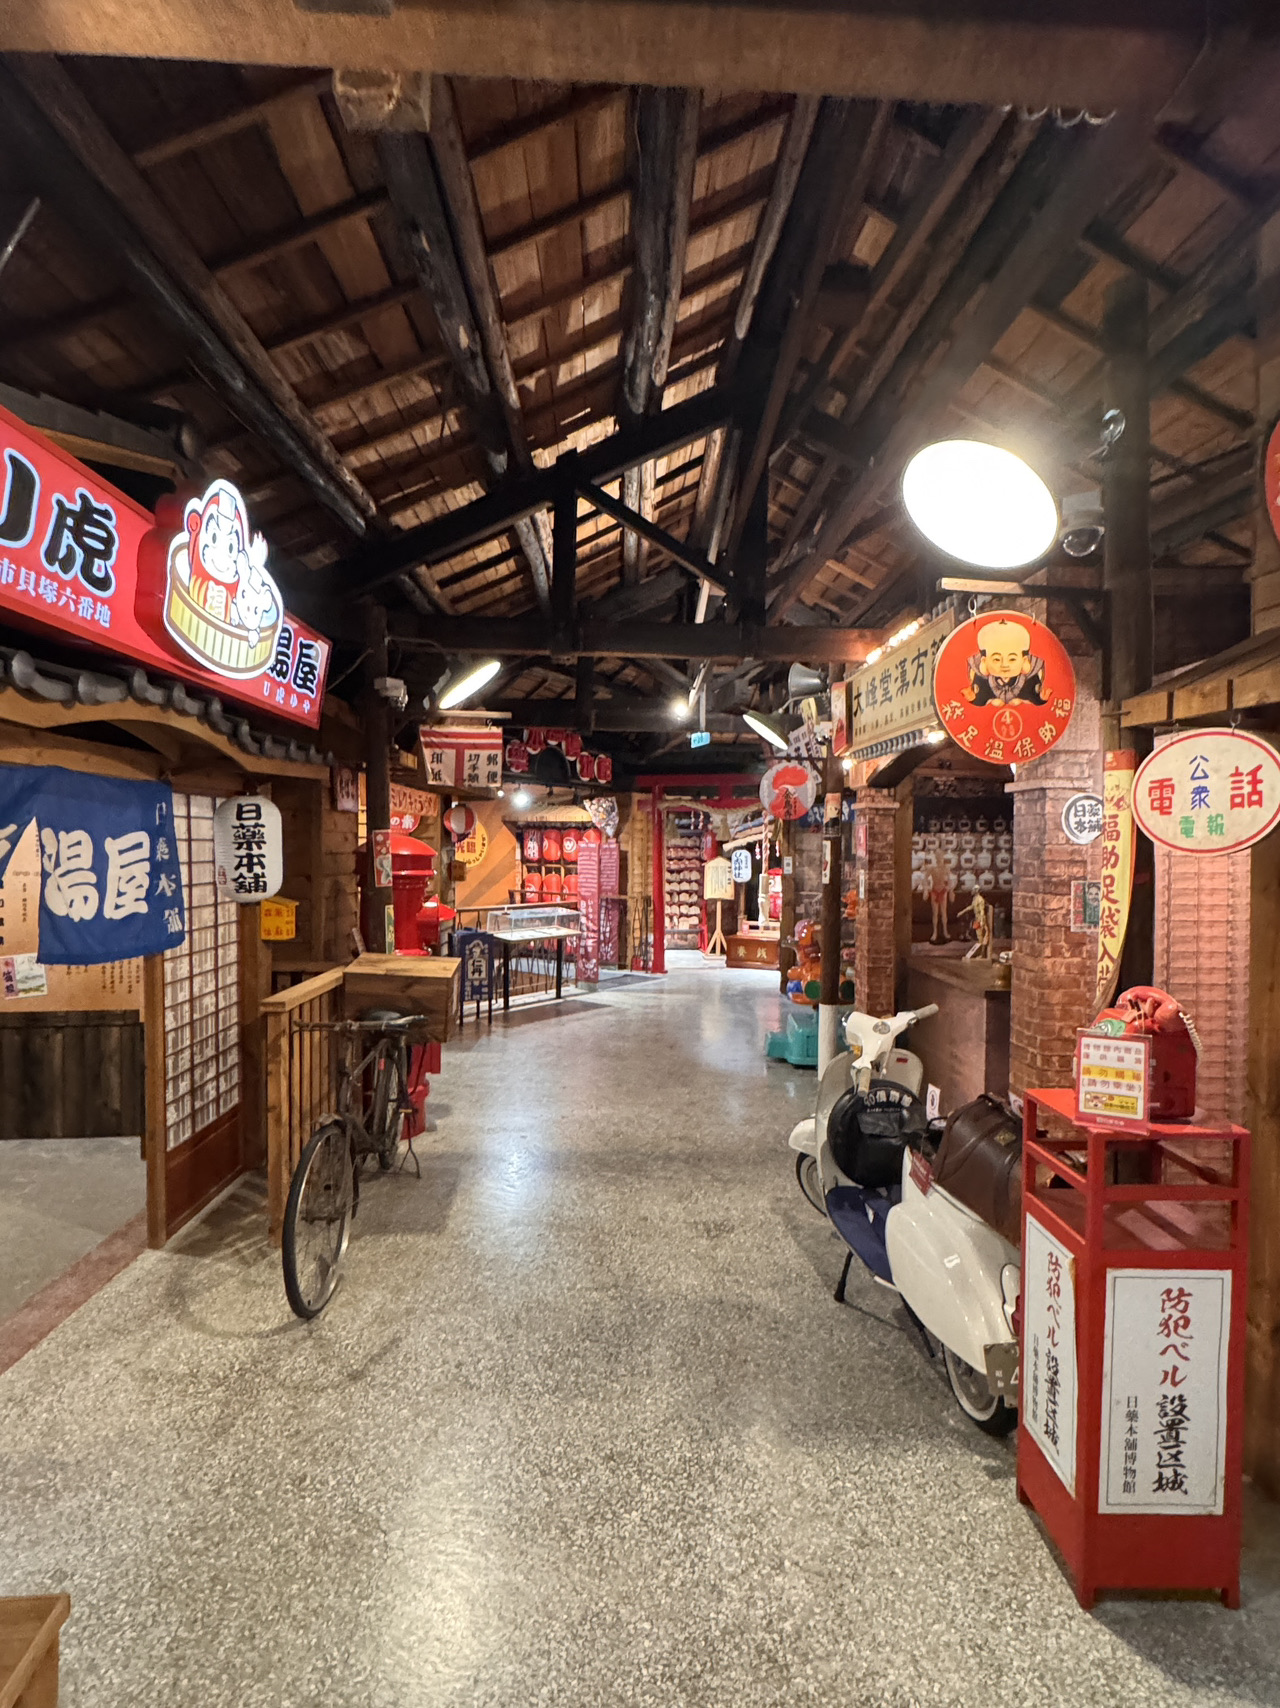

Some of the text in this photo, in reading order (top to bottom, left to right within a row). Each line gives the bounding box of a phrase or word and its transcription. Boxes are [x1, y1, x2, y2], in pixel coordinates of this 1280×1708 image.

[854, 634, 947, 718] 大峰堂漢方
[486, 753, 499, 784] 郵便
[1179, 813, 1225, 838] 電報
[41, 828, 150, 922] 湯屋
[471, 959, 483, 977] 仁丹
